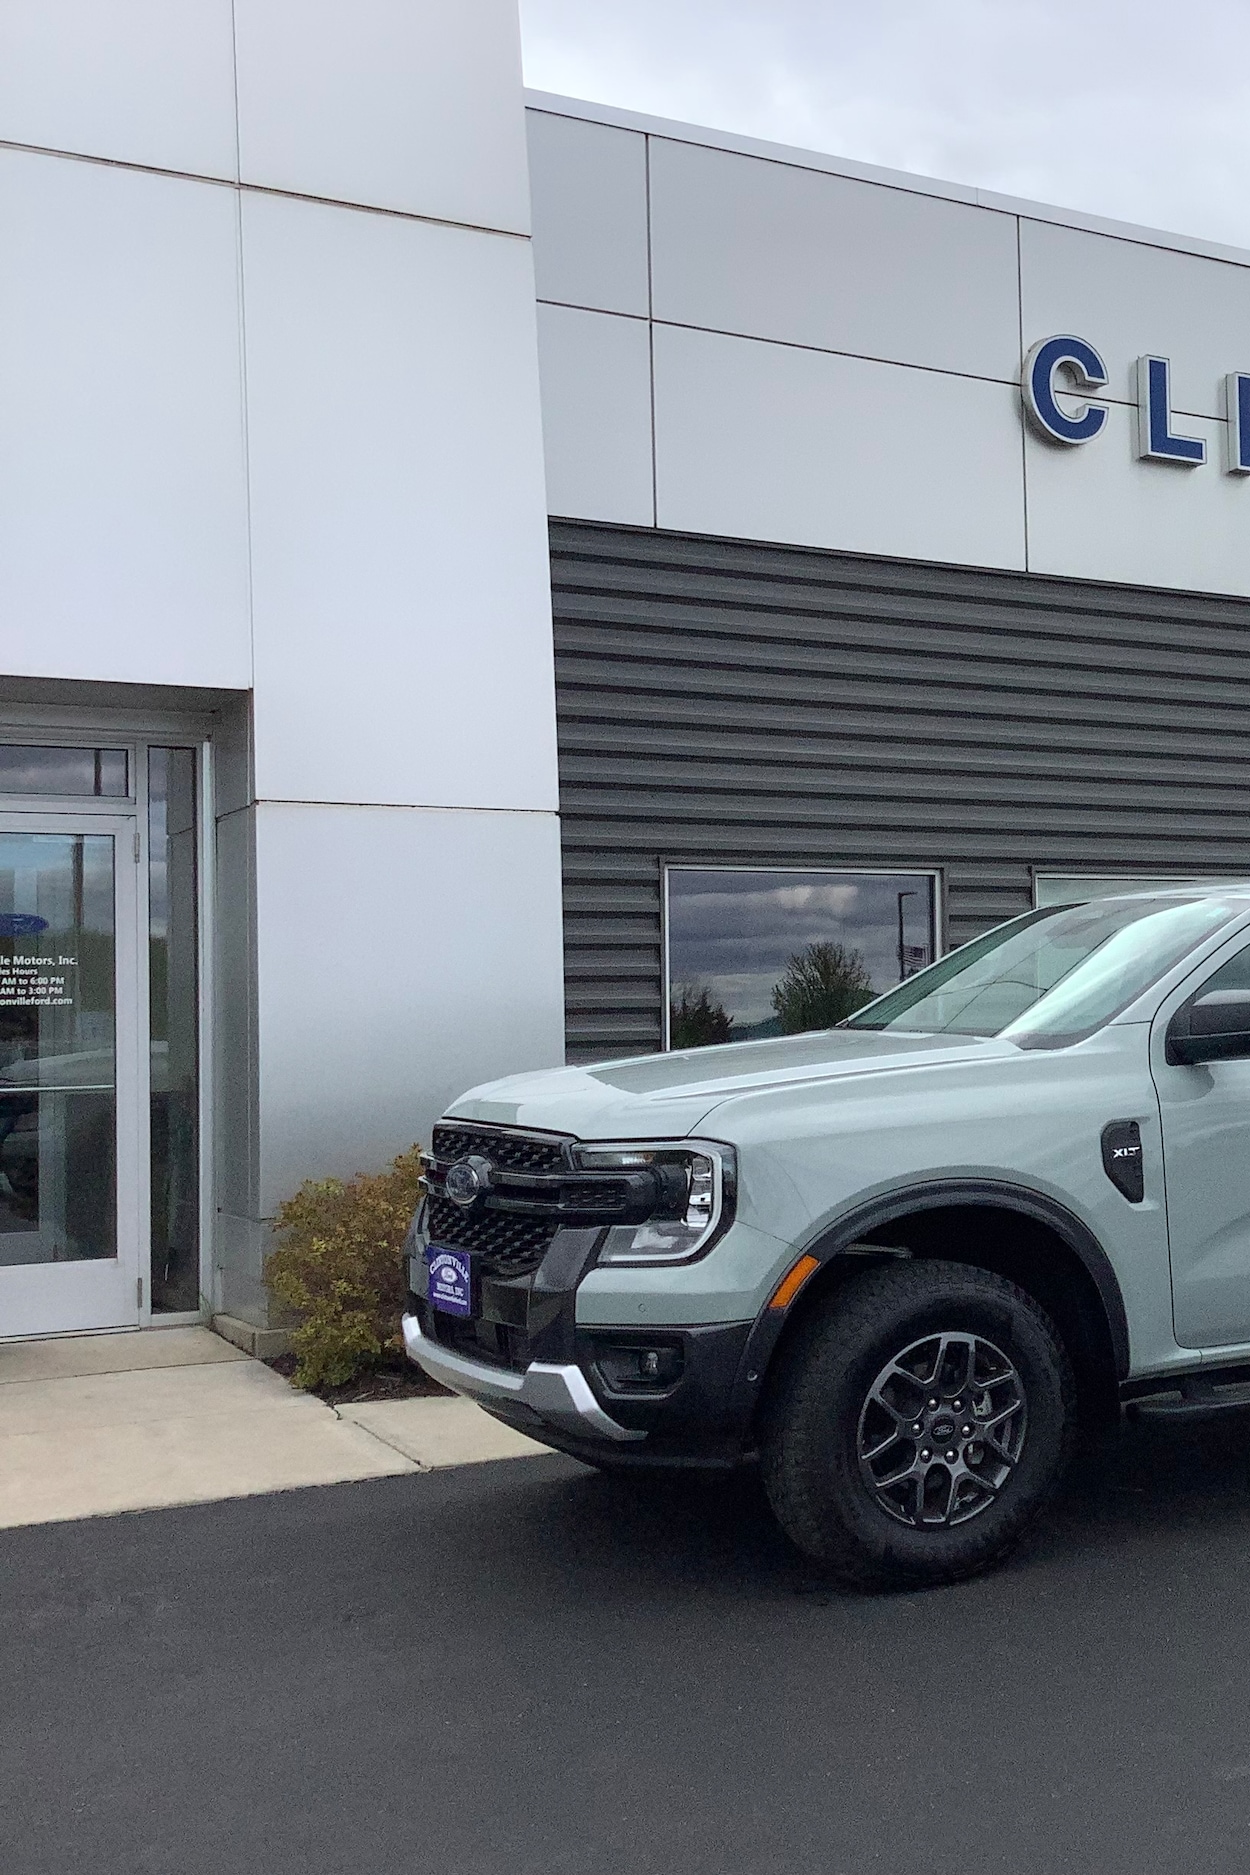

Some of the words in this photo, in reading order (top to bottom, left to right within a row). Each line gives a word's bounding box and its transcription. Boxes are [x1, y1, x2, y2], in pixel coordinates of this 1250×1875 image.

[13, 955, 56, 966] Motors,
[58, 955, 79, 966] Inc.
[12, 967, 38, 975] Hours
[1, 977, 17, 985] AM
[18, 977, 28, 985] to
[30, 977, 48, 985] 6:00
[50, 976, 65, 985] PM
[0, 987, 15, 995] AM
[17, 987, 27, 995] to
[28, 987, 47, 995] 3:00
[49, 986, 63, 994] PM
